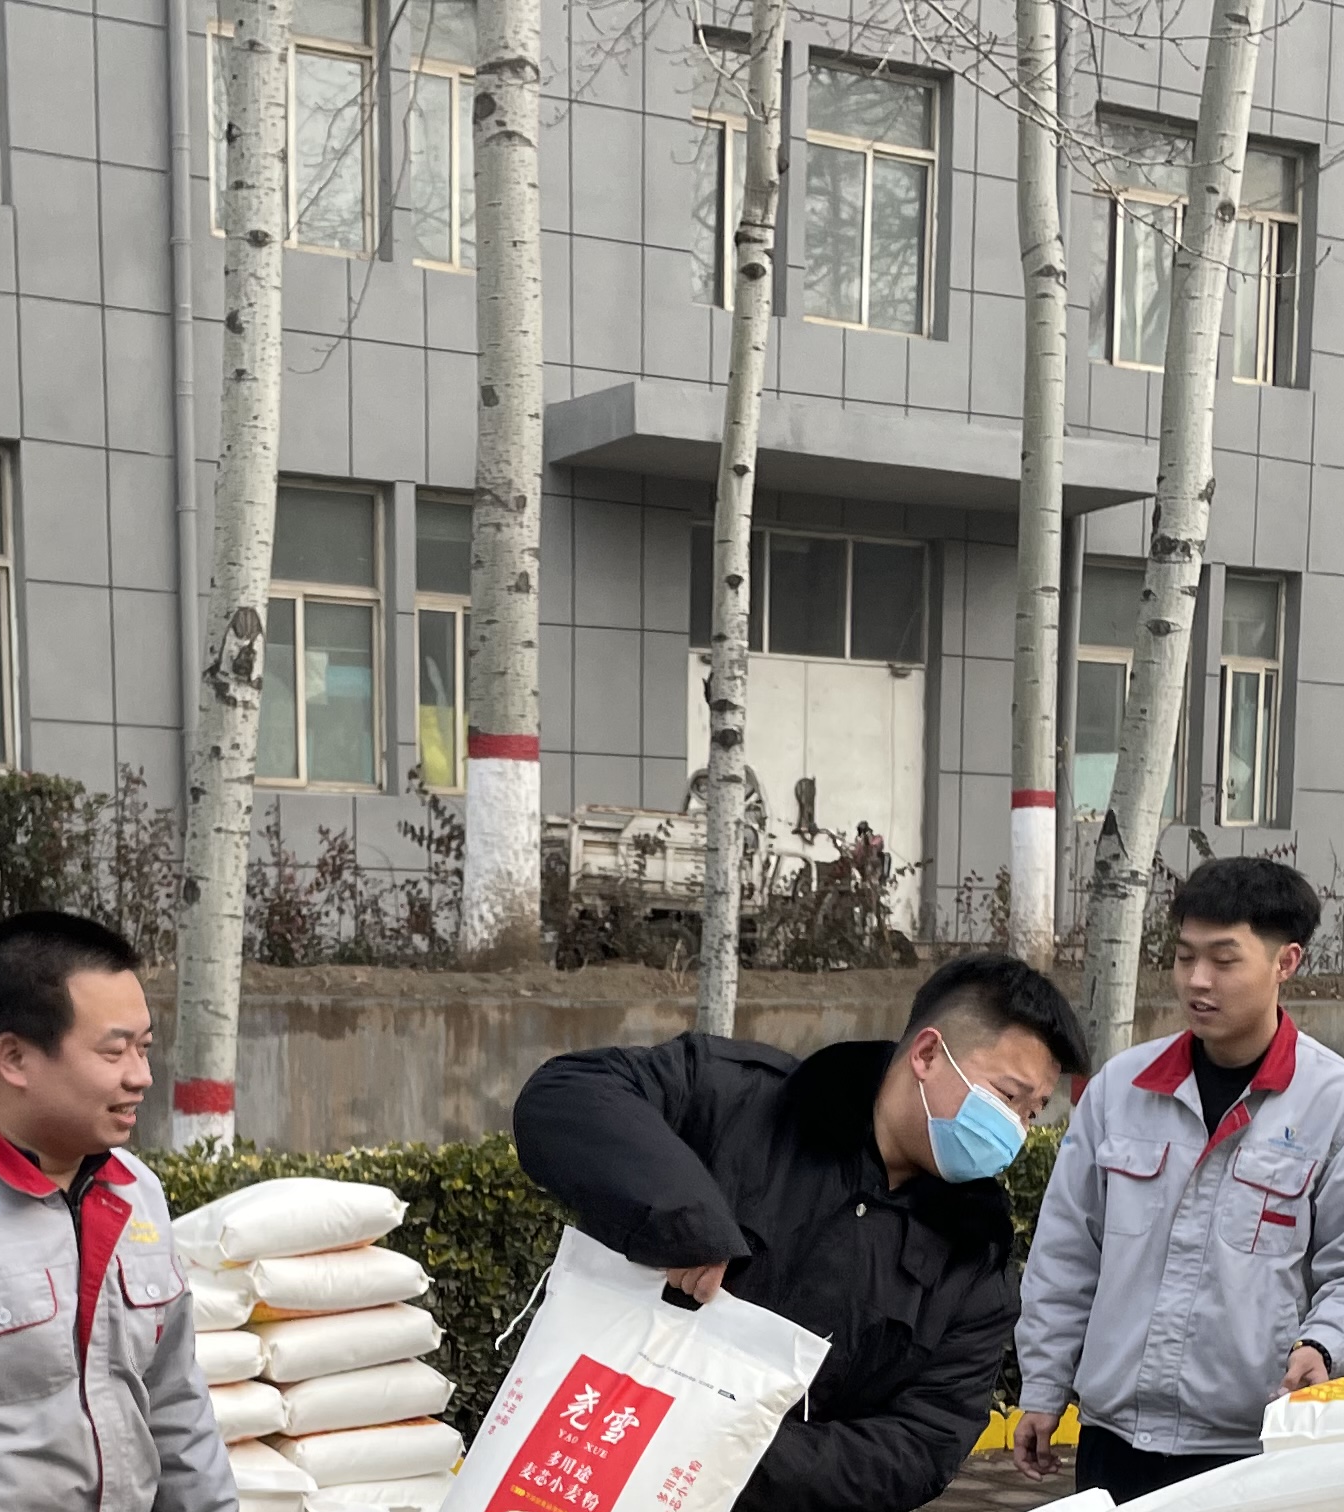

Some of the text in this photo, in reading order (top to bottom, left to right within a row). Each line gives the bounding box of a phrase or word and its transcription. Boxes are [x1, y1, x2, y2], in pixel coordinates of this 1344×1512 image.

[559, 1382, 640, 1446] 尧雪
[545, 1450, 594, 1486] 多用途
